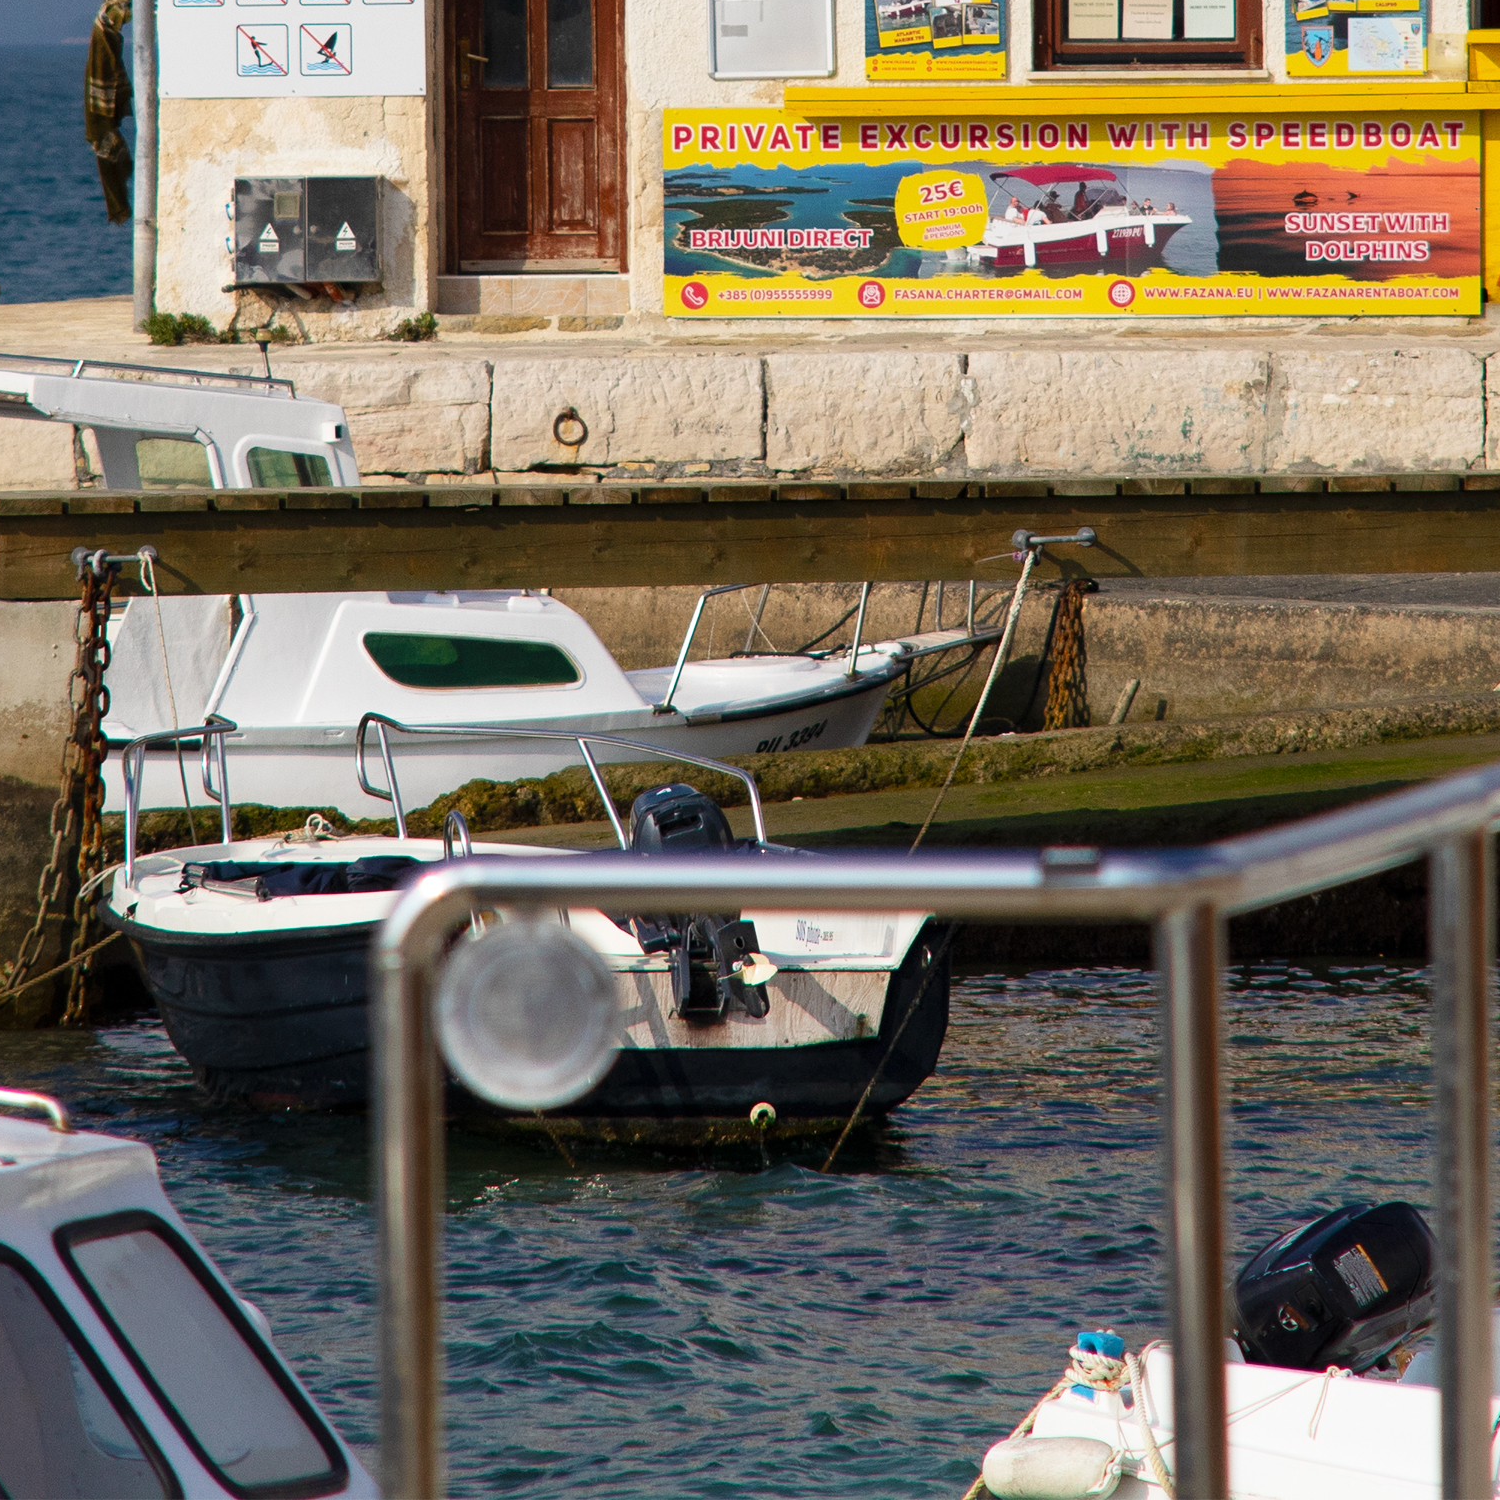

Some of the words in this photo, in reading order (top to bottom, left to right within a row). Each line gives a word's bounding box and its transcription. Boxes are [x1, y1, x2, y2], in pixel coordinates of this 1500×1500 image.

[672, 123, 842, 152] PRIVATE
[860, 122, 1089, 151] EXCURSION
[1106, 121, 1209, 150] WITH
[1227, 120, 1465, 150] SPEEDBOAT
[919, 179, 964, 204] 25€
[904, 209, 940, 224] START
[943, 203, 984, 217] 19:00h
[1284, 212, 1381, 234] SUNSET
[1385, 212, 1450, 233] WITH
[690, 228, 788, 250] BRIJUNI
[789, 227, 874, 249] DIRECT
[925, 223, 962, 233] MINIMUM
[930, 229, 965, 239] PERSONS
[1305, 240, 1430, 262] DOLPHINS
[717, 290, 747, 301] +385
[894, 288, 1083, 300] FASANA.CHARTER@GMAIL.COM
[1143, 286, 1253, 299] WWW.FAZANA.EU
[1266, 286, 1460, 299] WWW.FAZANARENTABOAT.COM
